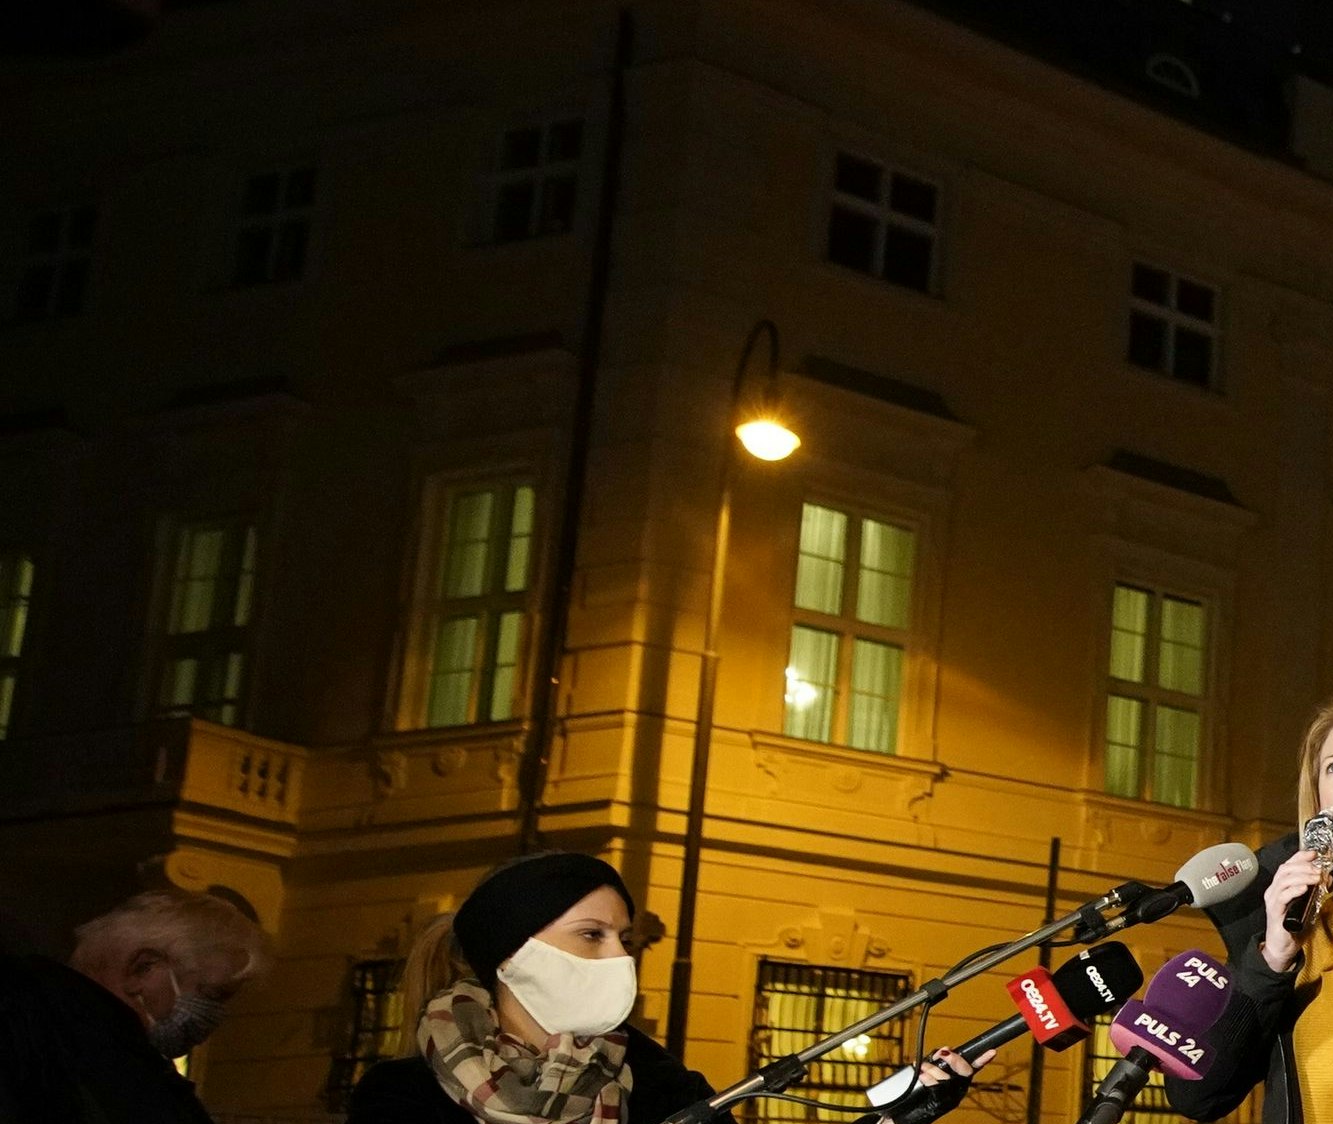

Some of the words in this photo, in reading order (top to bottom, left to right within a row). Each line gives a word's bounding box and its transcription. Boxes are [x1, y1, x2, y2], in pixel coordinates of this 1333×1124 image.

[1184, 957, 1229, 990] PULS
[1134, 1013, 1182, 1046] PULS
[1177, 1037, 1205, 1065] 24
